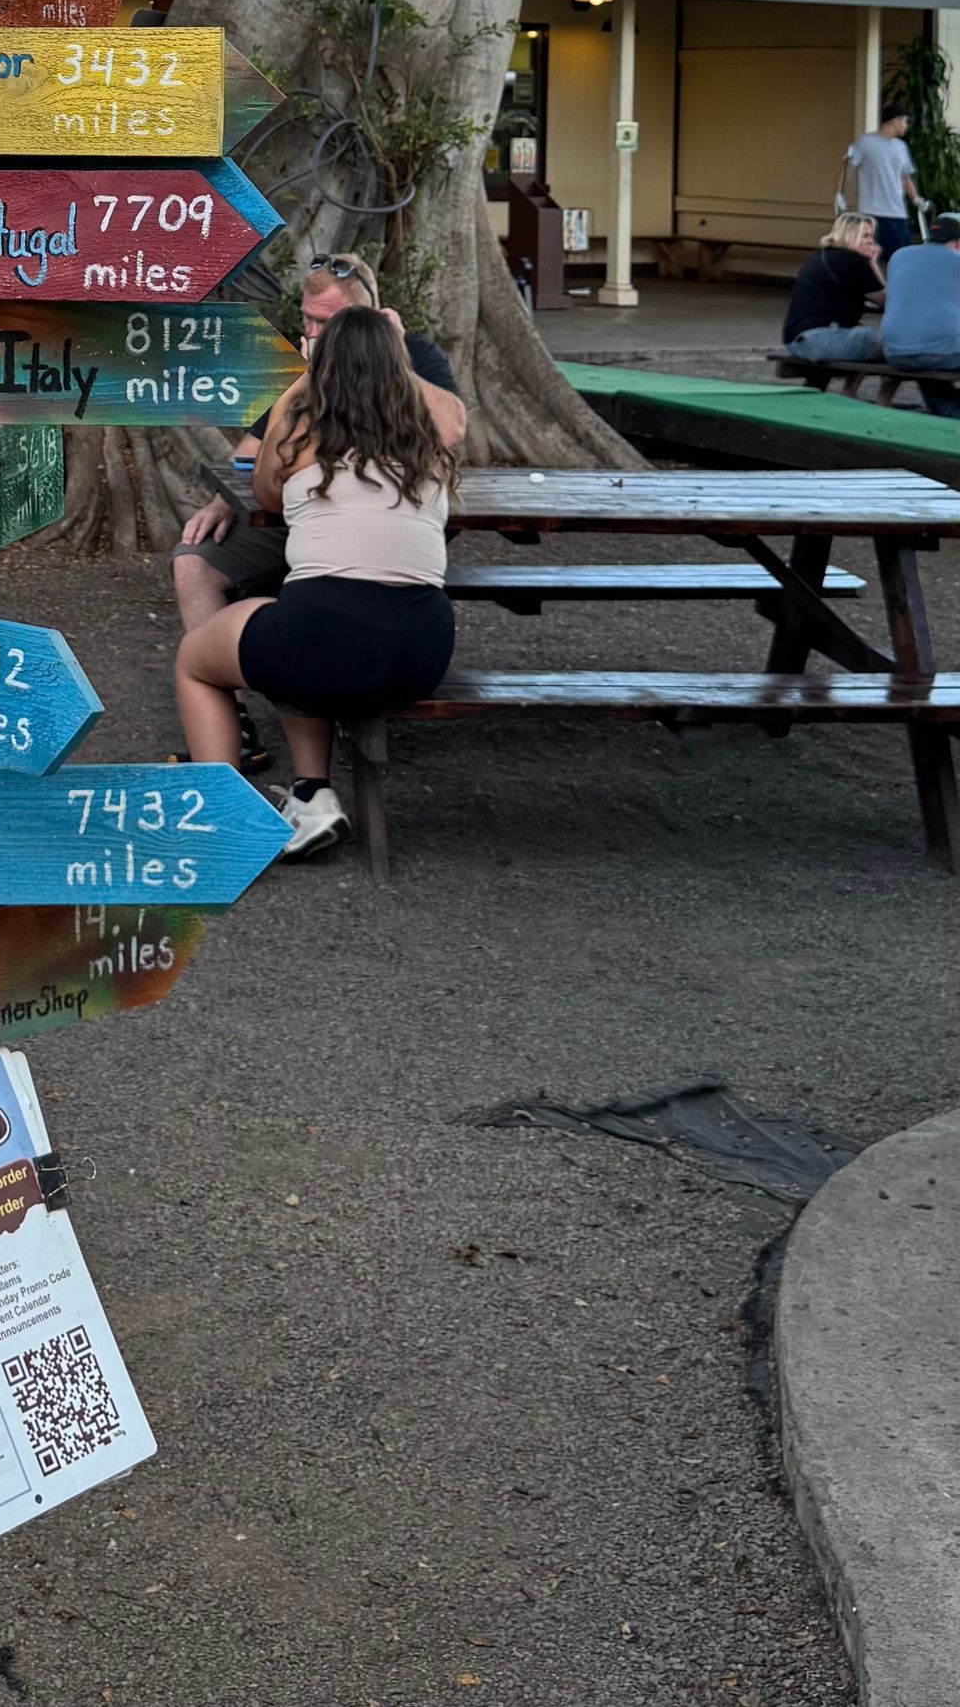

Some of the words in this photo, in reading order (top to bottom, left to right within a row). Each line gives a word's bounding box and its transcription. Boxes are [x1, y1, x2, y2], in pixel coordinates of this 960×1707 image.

[57, 44, 185, 86] 3432
[53, 101, 176, 135] miles
[93, 193, 214, 240] 7709
[83, 250, 194, 292] miles
[125, 311, 224, 356] 8124
[126, 365, 241, 406] miles
[16, 427, 58, 473] 5618
[67, 788, 217, 835] 7432
[66, 841, 199, 889] miles
[89, 935, 176, 980] miles
[20, 1279, 48, 1298] Promo
[48, 1267, 72, 1284] Code
[14, 1292, 52, 1317] Calendar
